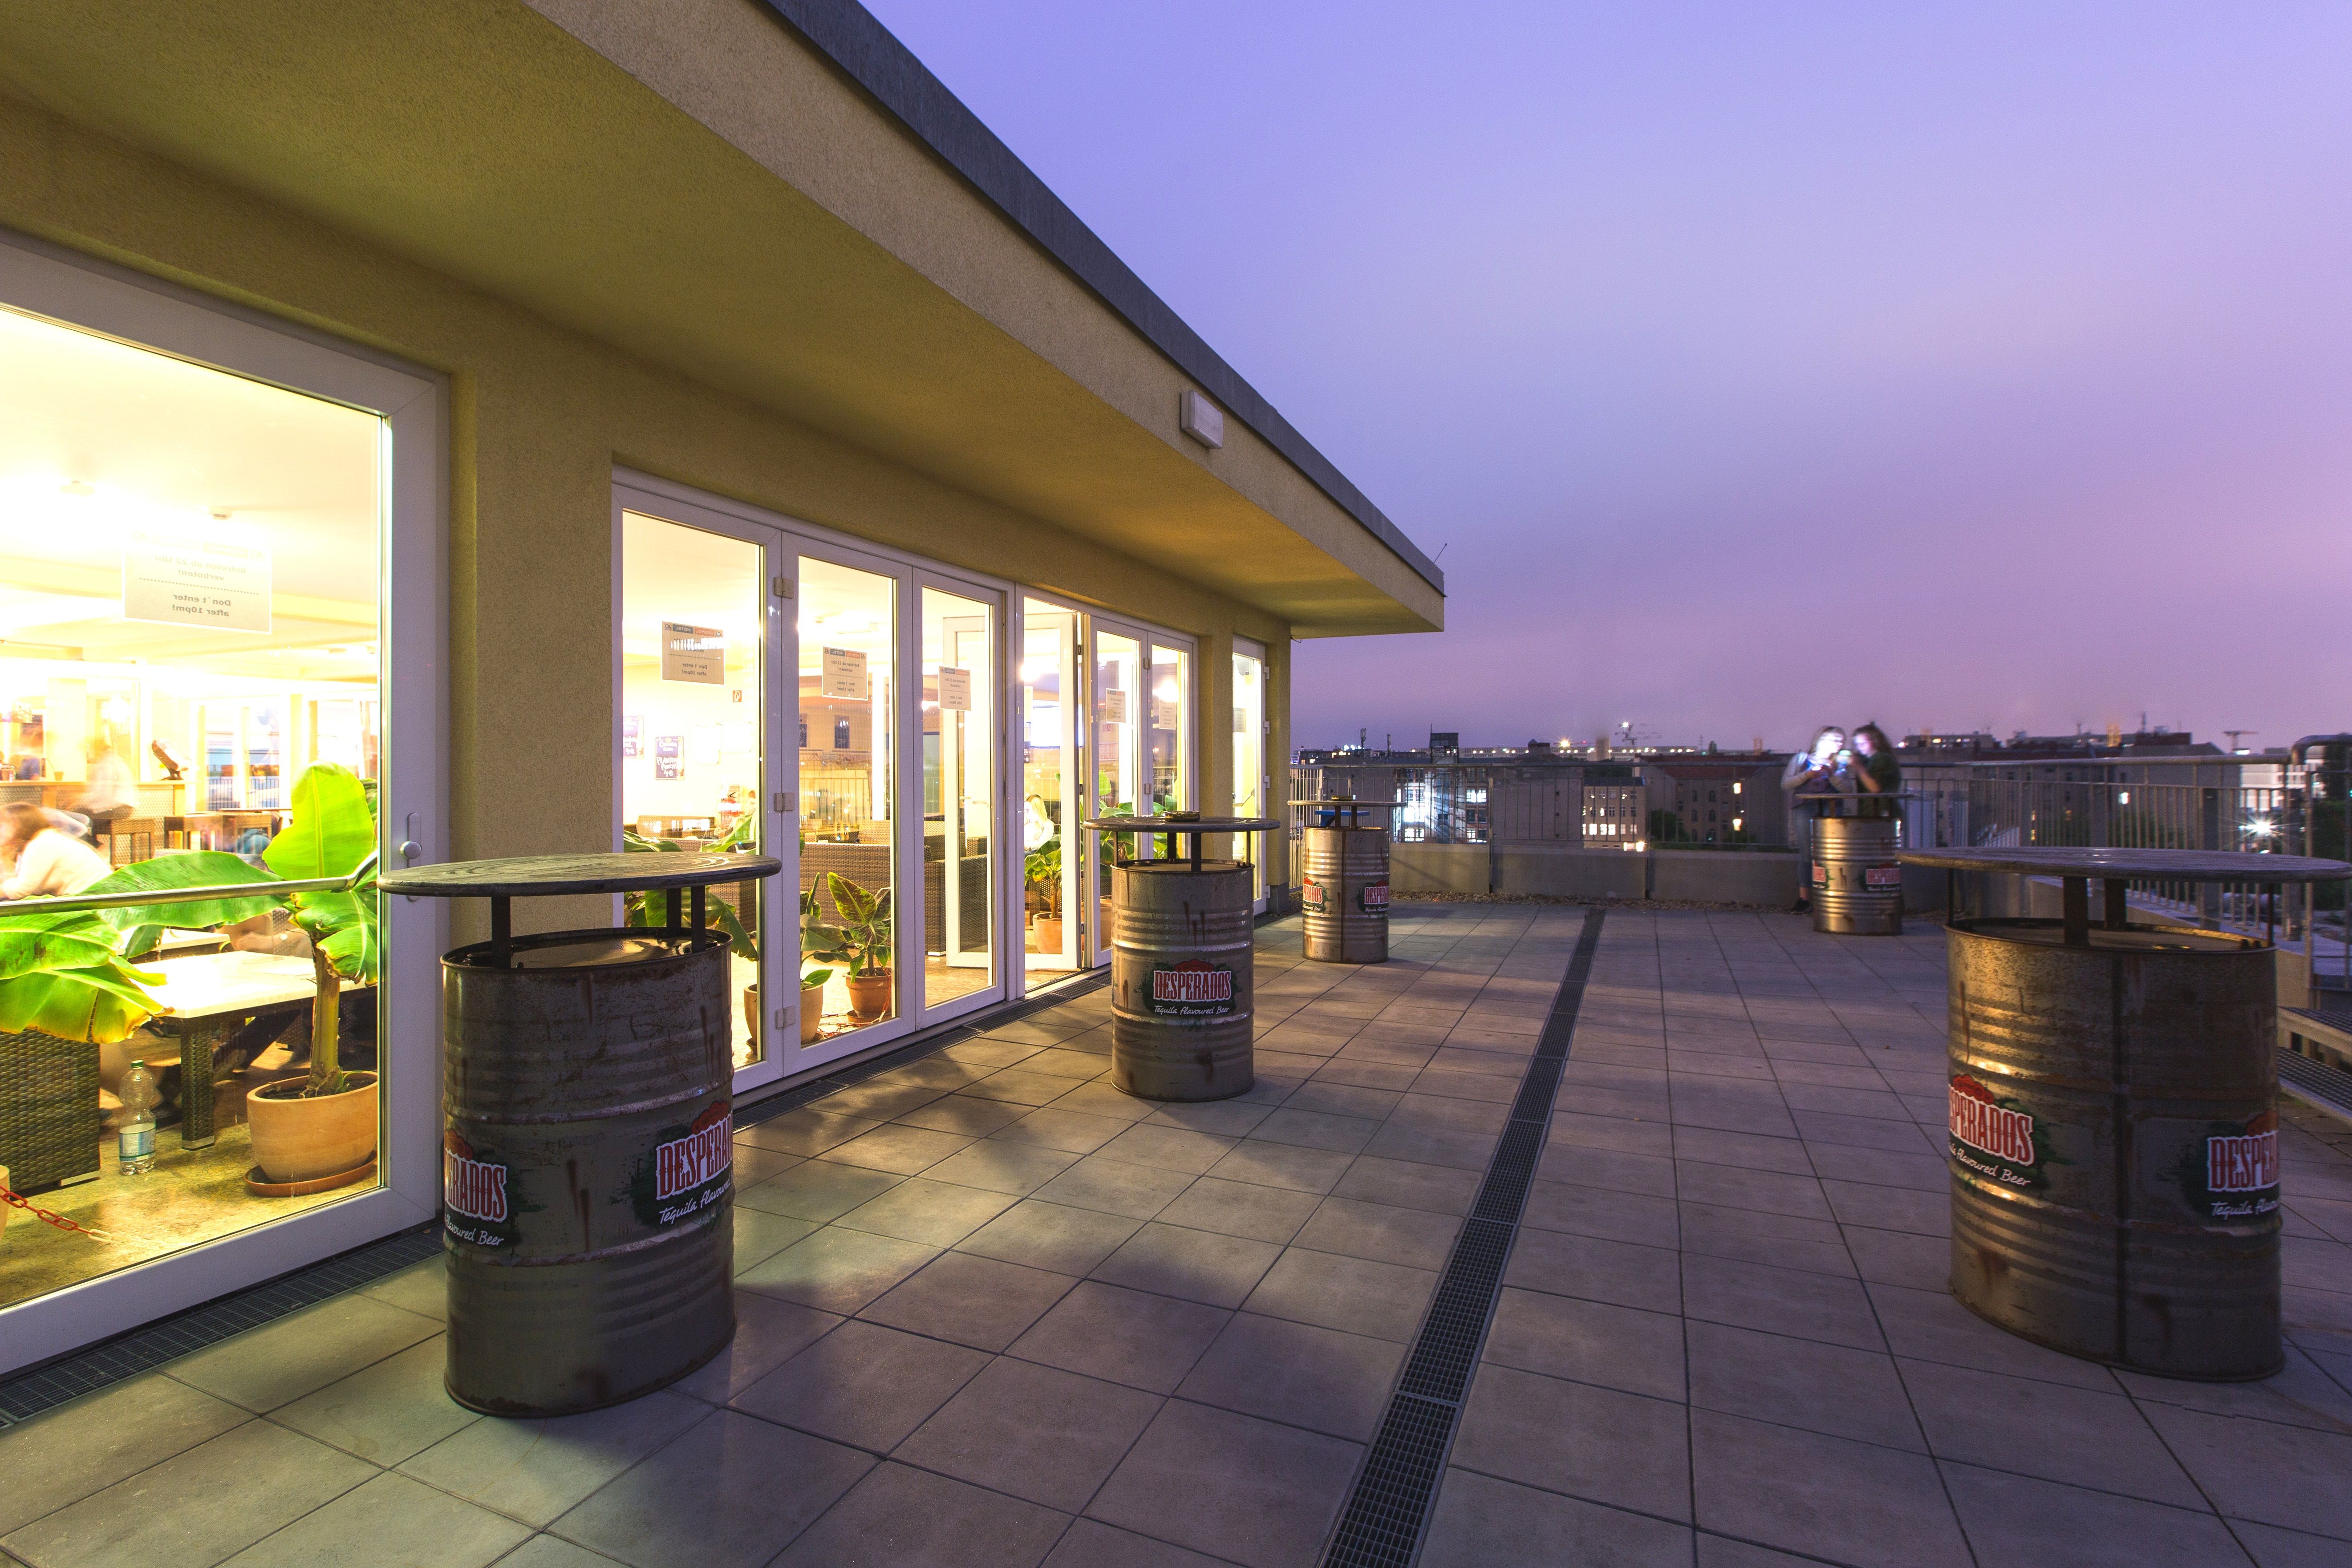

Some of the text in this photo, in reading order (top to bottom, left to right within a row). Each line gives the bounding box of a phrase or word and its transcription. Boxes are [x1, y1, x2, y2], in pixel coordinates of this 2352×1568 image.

[1154, 971, 1231, 1001] DESPERADOS
[1154, 1005, 1230, 1016] Tequila flavoured Beer
[1956, 1147, 1997, 1177] flavoured
[1999, 1168, 2032, 1187] Beer
[659, 1198, 697, 1224] Tequila
[2210, 1200, 2253, 1220] Tequila
[477, 1231, 505, 1247] Beer
